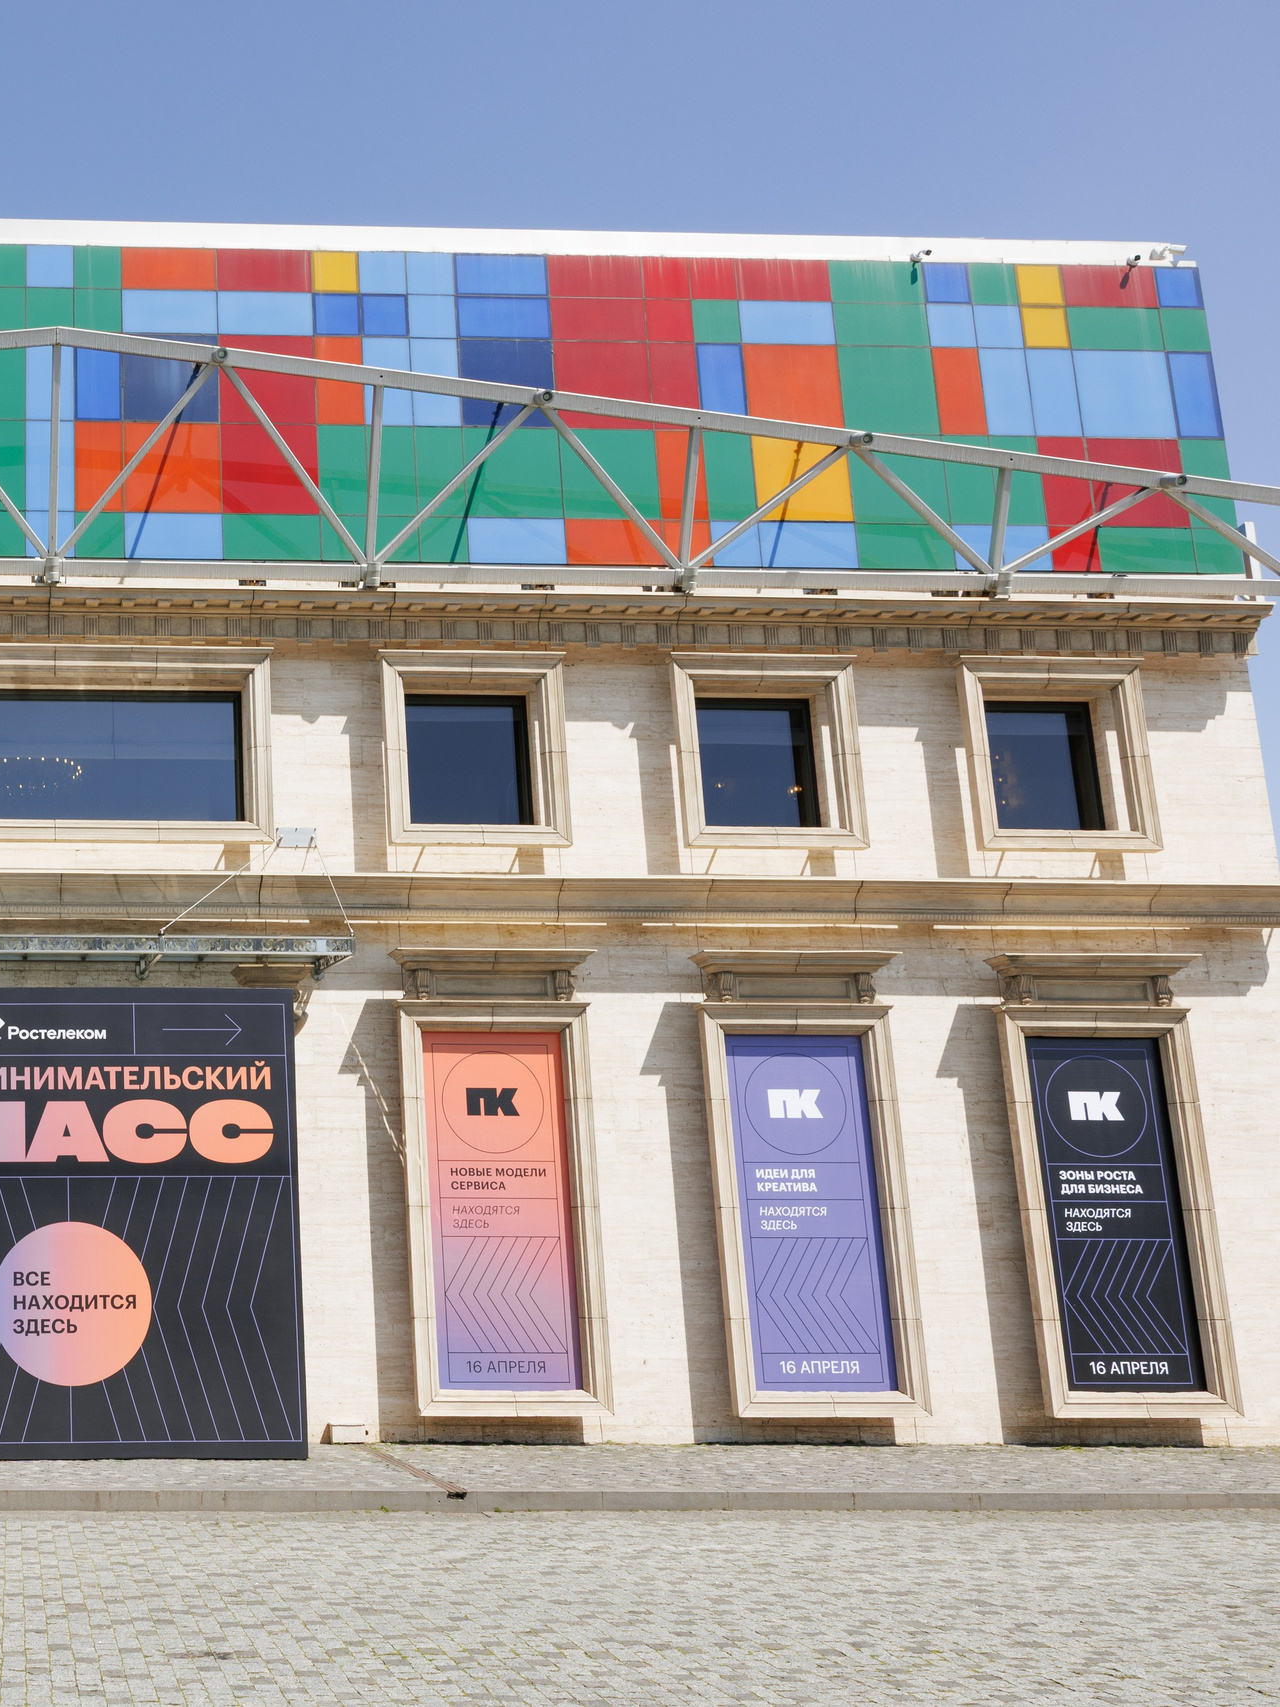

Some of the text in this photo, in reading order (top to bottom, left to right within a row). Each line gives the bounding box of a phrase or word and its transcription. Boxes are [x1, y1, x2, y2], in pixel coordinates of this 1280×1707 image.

[7, 1025, 107, 1041] Ростелеком
[465, 1087, 520, 1116] ПК
[767, 1089, 824, 1119] ПК
[1067, 1091, 1125, 1121] ПК
[450, 1167, 547, 1179] НОВЫЕ МОДЕЛИ
[755, 1168, 816, 1181] ИДЕИ ДЛЯ
[1059, 1170, 1136, 1181] ЗОНЫ РОСТА
[450, 1180, 506, 1190] СЕРВИСА
[756, 1182, 818, 1192] КРЕАТИВА
[1061, 1183, 1143, 1196] ДЛЯ БИЗНЕСА
[452, 1205, 520, 1217] НАХОДЯТСЯ
[759, 1206, 827, 1218] НАХОДЯТСЯ
[1064, 1208, 1132, 1220] НАХОДЯТСЯ
[452, 1219, 490, 1230] ЗДЕСЬ
[760, 1220, 798, 1232] ЗДЕСЬ
[1065, 1221, 1103, 1233] ЗДЕСЬ
[12, 1271, 51, 1287] ВСЕ
[12, 1294, 137, 1313] НАХОДИТСЯ
[12, 1318, 78, 1337] ЗДЕСЬ
[466, 1360, 546, 1374] 16 АПРЕЛЯ
[779, 1360, 860, 1374] 16 АПРЕЛЯ
[1089, 1361, 1169, 1375] 16 АПРЕЛЯ
